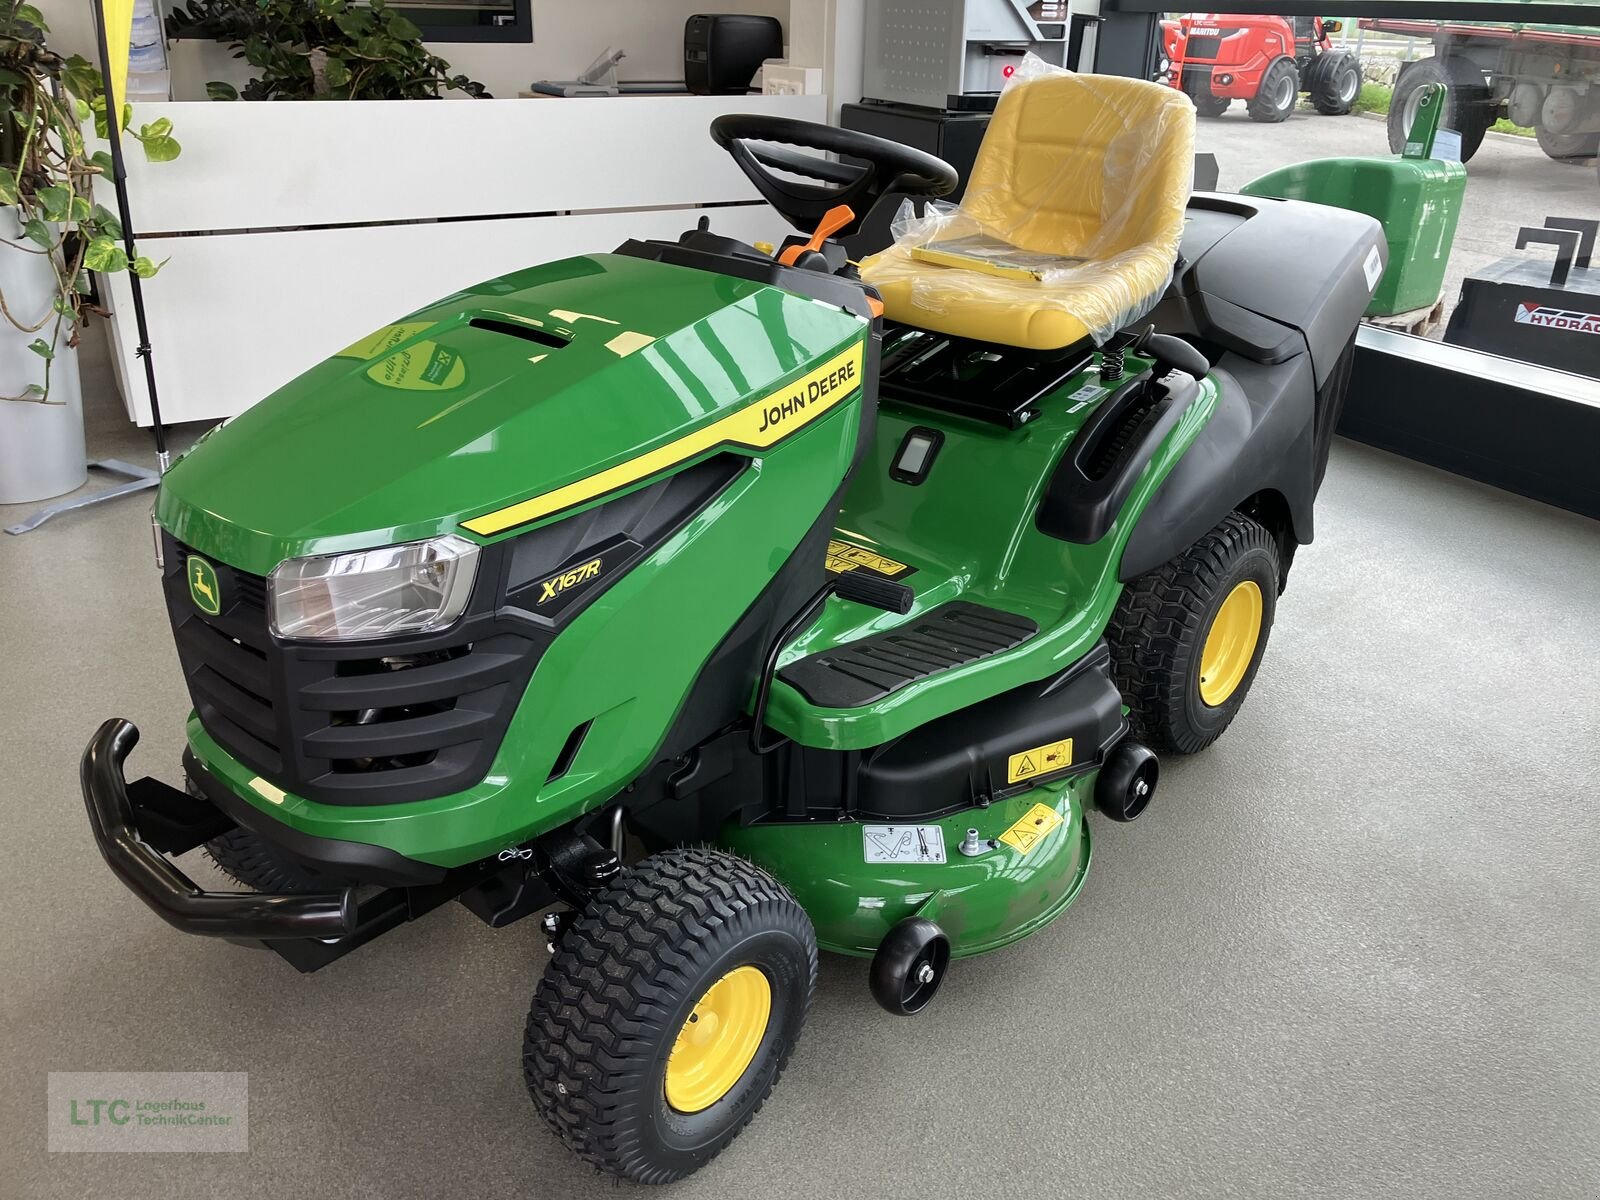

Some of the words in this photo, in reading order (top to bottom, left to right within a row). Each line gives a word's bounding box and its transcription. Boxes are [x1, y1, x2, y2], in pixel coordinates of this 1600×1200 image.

[1190, 28, 1220, 36] MANITOU
[759, 391, 806, 432] JOHN
[807, 359, 855, 405] DEERE
[537, 558, 602, 604] X167R
